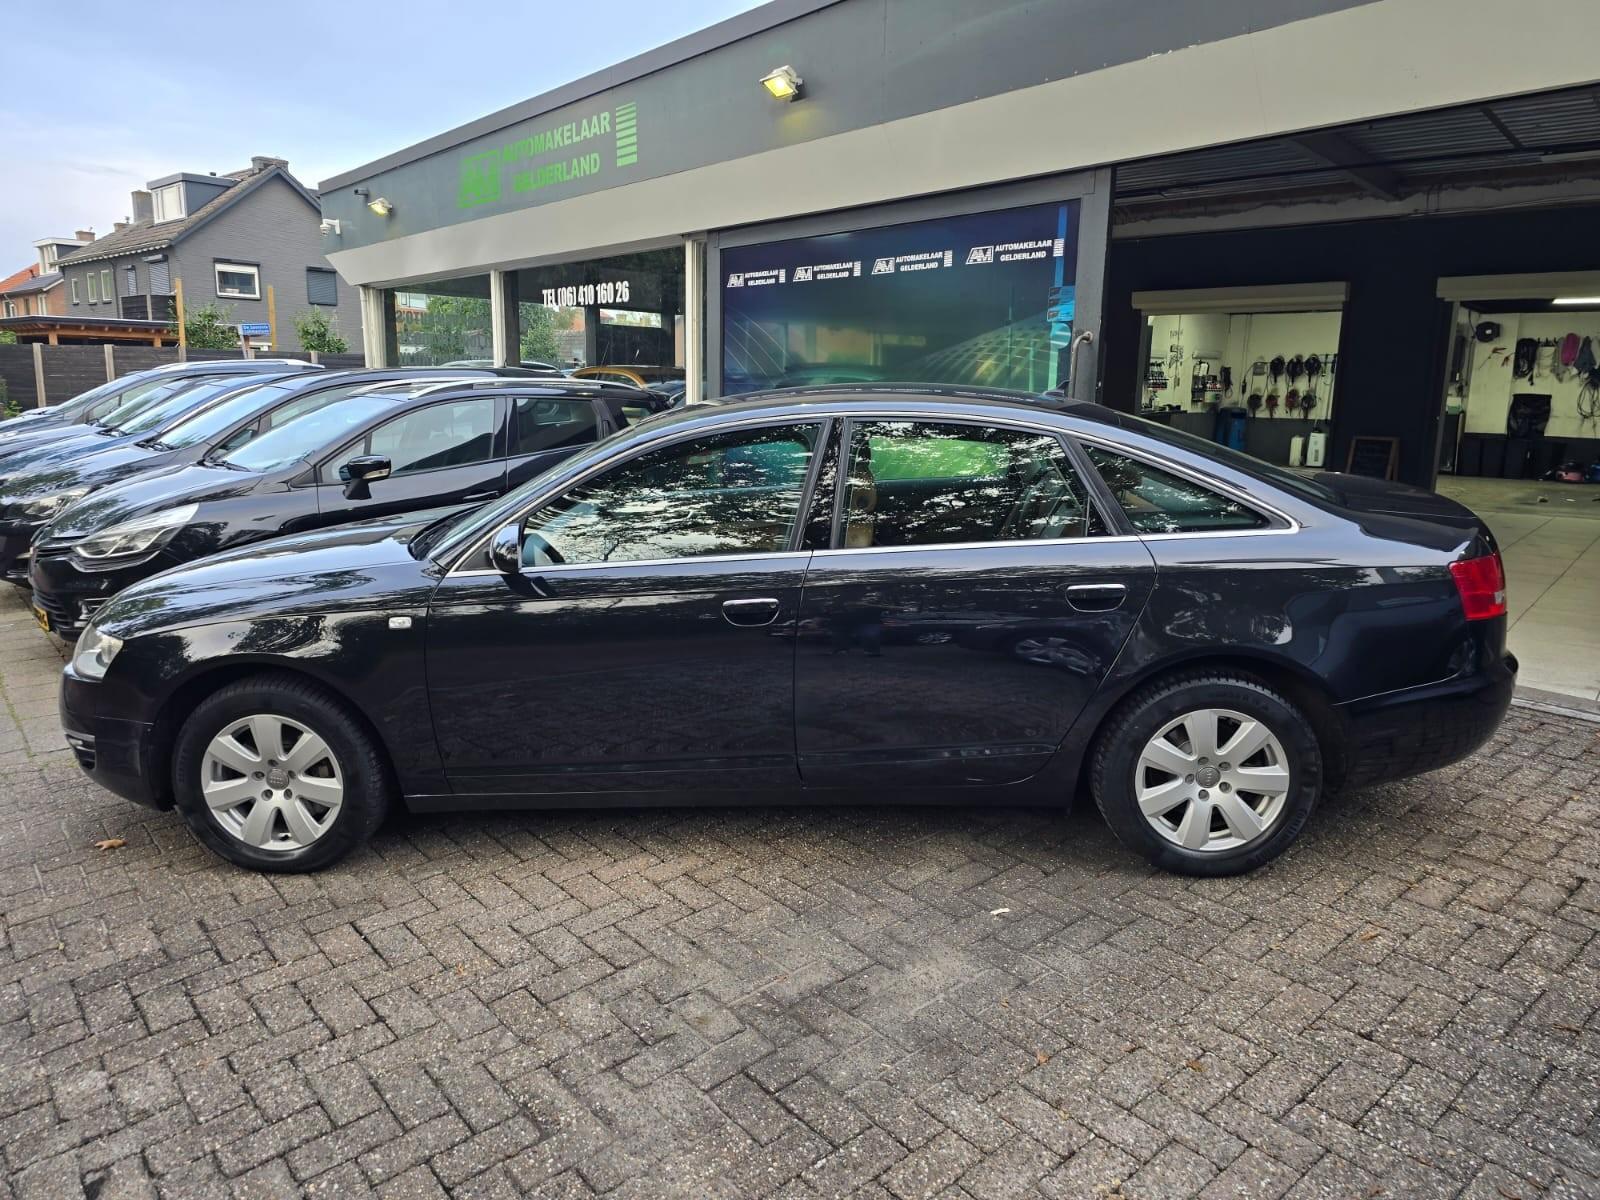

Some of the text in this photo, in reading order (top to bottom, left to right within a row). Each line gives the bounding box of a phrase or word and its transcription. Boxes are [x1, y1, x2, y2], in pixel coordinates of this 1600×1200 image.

[502, 111, 611, 162] AUTOMAKELAAR
[994, 239, 1052, 252] AUTOMAKELAAR
[896, 251, 943, 263] AUTOMAKELAAR
[1000, 251, 1046, 262] GELDERLAND
[900, 262, 938, 272] GELDERLAND
[557, 286, 576, 307] (06)
[578, 285, 594, 305] 410
[596, 282, 614, 304] 160
[615, 280, 629, 303] 26
